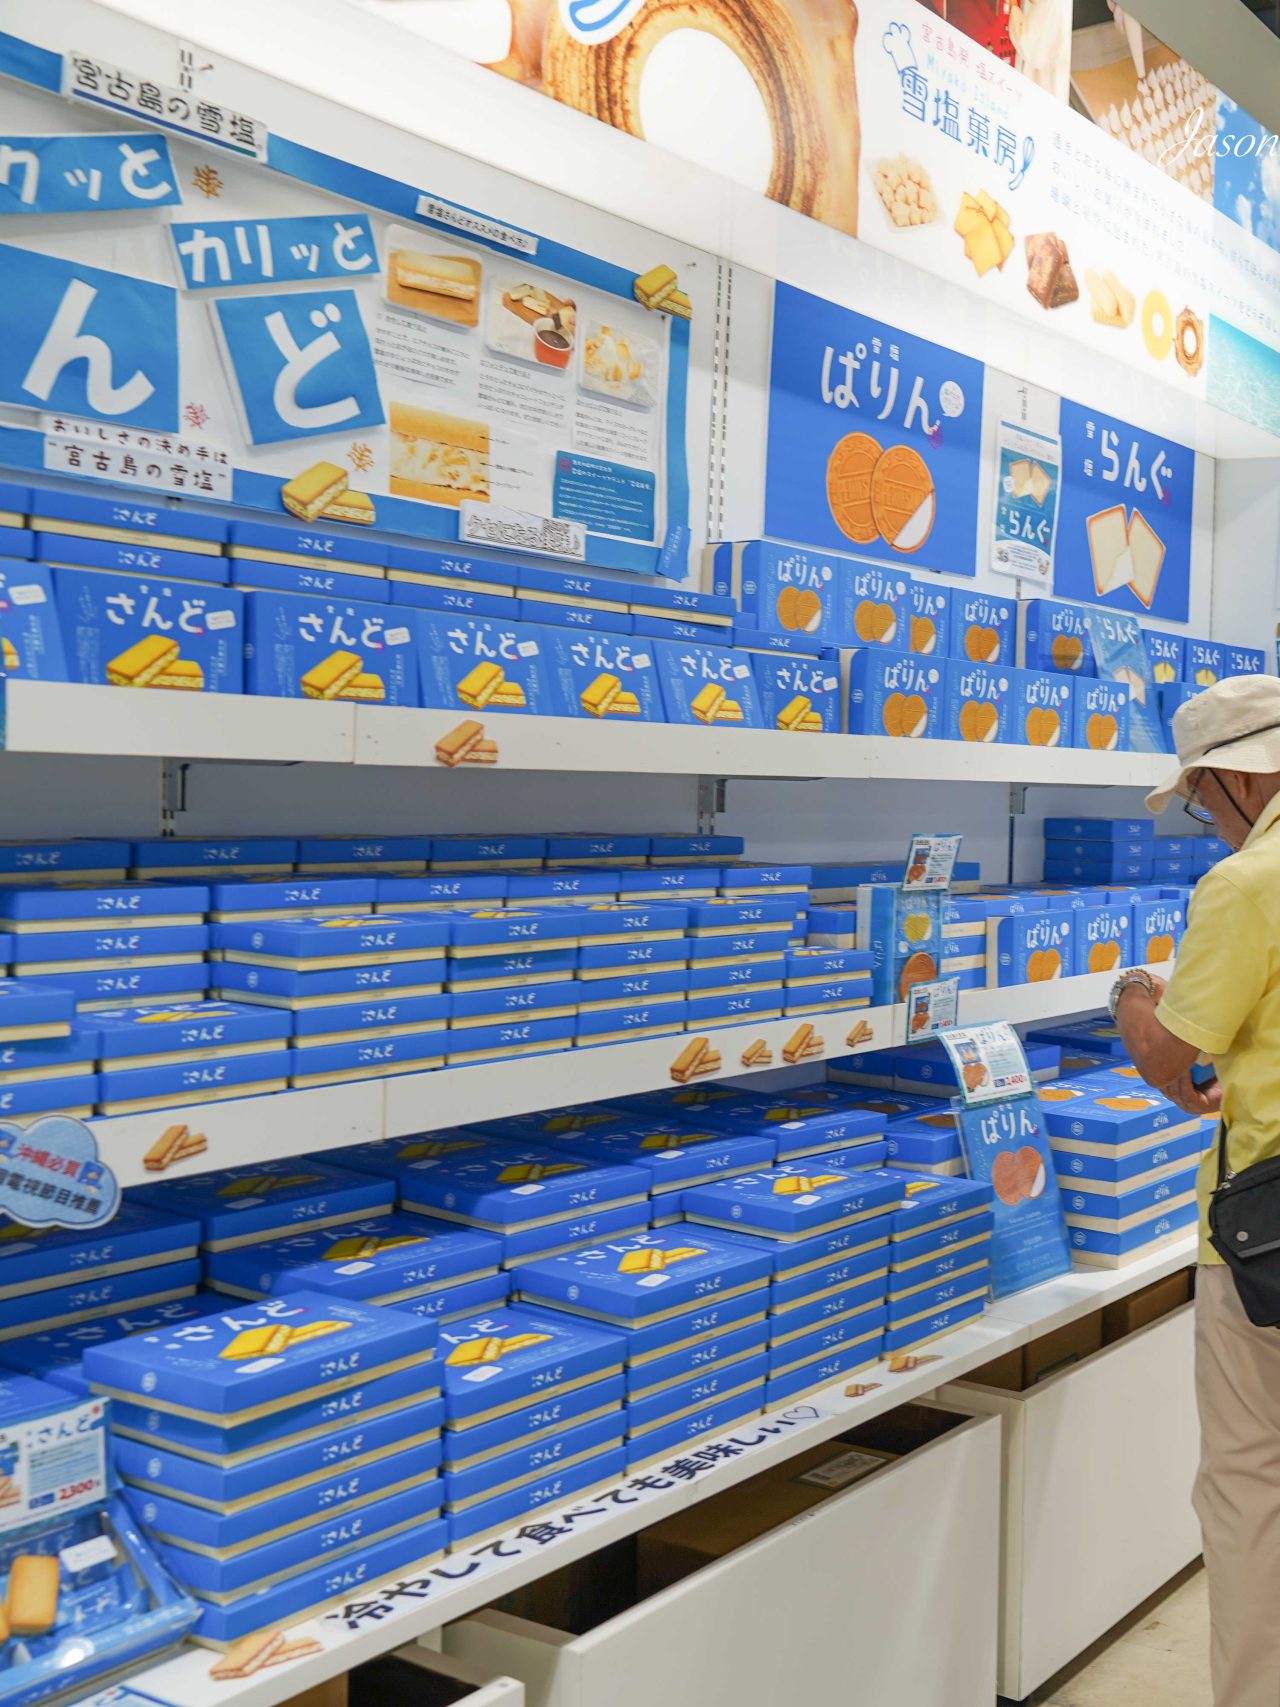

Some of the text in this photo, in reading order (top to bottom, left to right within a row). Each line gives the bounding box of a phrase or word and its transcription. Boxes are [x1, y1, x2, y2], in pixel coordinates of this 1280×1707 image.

[72, 56, 259, 147] 宮古島の雪塩
[900, 66, 1018, 175] 雪塩菓房
[178, 221, 375, 282] カリッと
[821, 341, 940, 436] ぱりん
[52, 418, 229, 465] おいしさの決め手は
[1100, 428, 1174, 500] らんぐ
[778, 555, 822, 588] ぱりん
[855, 571, 897, 603] ぱりん
[107, 588, 205, 634] さんど
[965, 599, 1000, 626] ぱりん
[299, 613, 383, 649] さんど
[448, 629, 518, 660] さんど
[1104, 617, 1138, 644] らんぐ
[571, 637, 633, 671] さんど
[1155, 640, 1178, 659] らんぐ
[1198, 647, 1219, 665] らんぐ
[1236, 654, 1259, 671] らんぐ
[681, 651, 734, 681] さんど
[777, 664, 823, 693] さんど
[885, 659, 929, 694] ぱりん
[960, 670, 999, 700] ぱりん
[1027, 678, 1061, 707] ぱりん
[1087, 686, 1119, 713] ぱりん
[1027, 919, 1062, 948] ぱりん
[1088, 913, 1120, 940] ぱりん
[1146, 908, 1175, 933] ぱりん
[981, 1104, 1037, 1144] ぱりん
